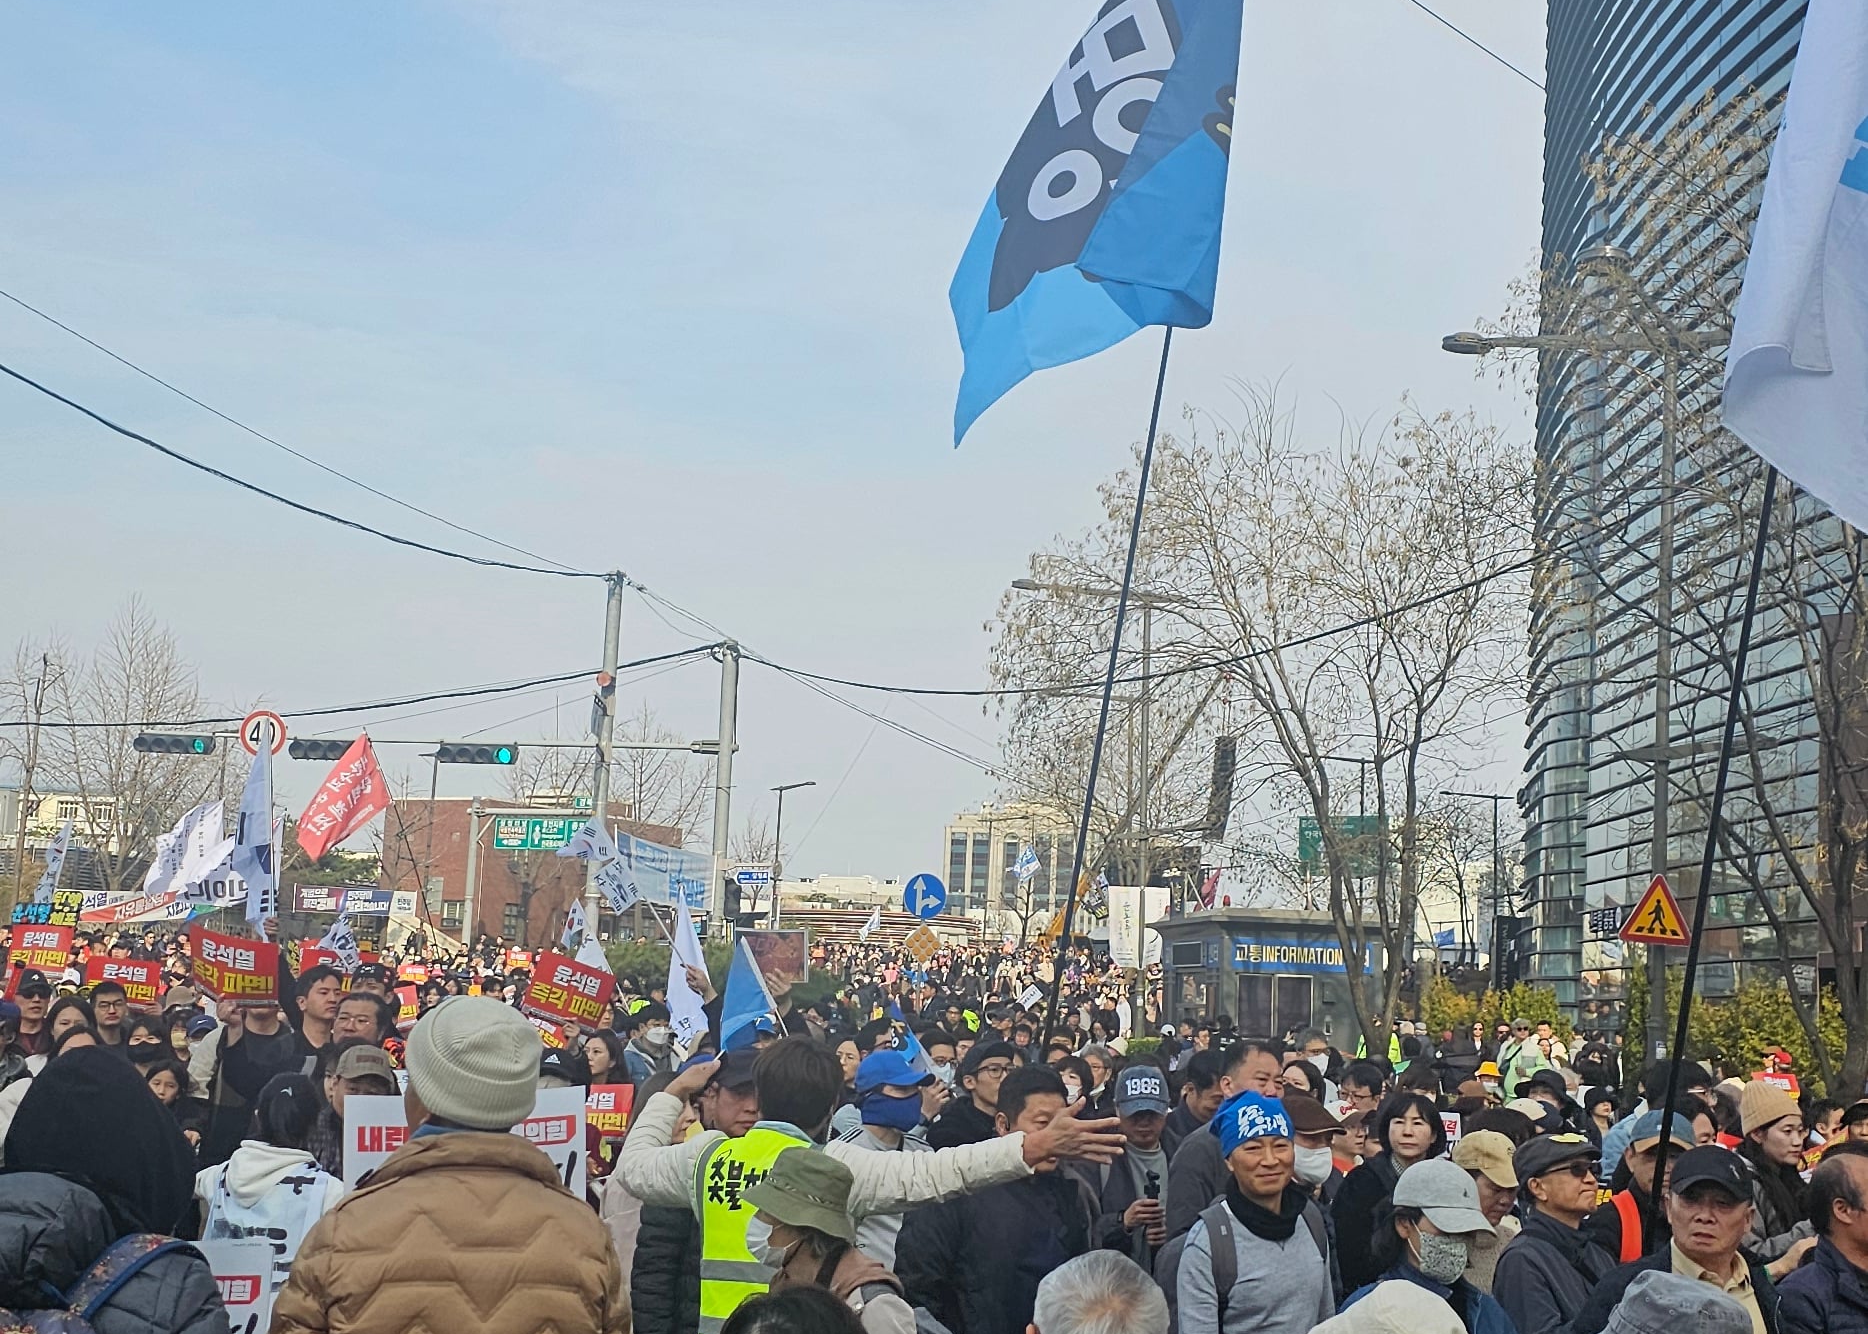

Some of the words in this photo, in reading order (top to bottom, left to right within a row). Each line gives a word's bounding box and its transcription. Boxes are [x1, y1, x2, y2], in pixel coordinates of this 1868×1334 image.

[81, 892, 107, 908] 석열
[22, 932, 59, 948] 윤석열
[32, 949, 67, 968] 파면!
[201, 938, 255, 971] 윤석열
[1235, 944, 1369, 966] 교통INFORMATION
[103, 963, 148, 982] 윤석열
[191, 956, 219, 989] 즉각
[223, 973, 274, 995] 파면!
[553, 965, 601, 997] 윤석열
[530, 981, 568, 1010] 즉각
[568, 993, 603, 1021] 파면!
[510, 1120, 568, 1145] 의힘
[586, 1112, 628, 1132] 파면!
